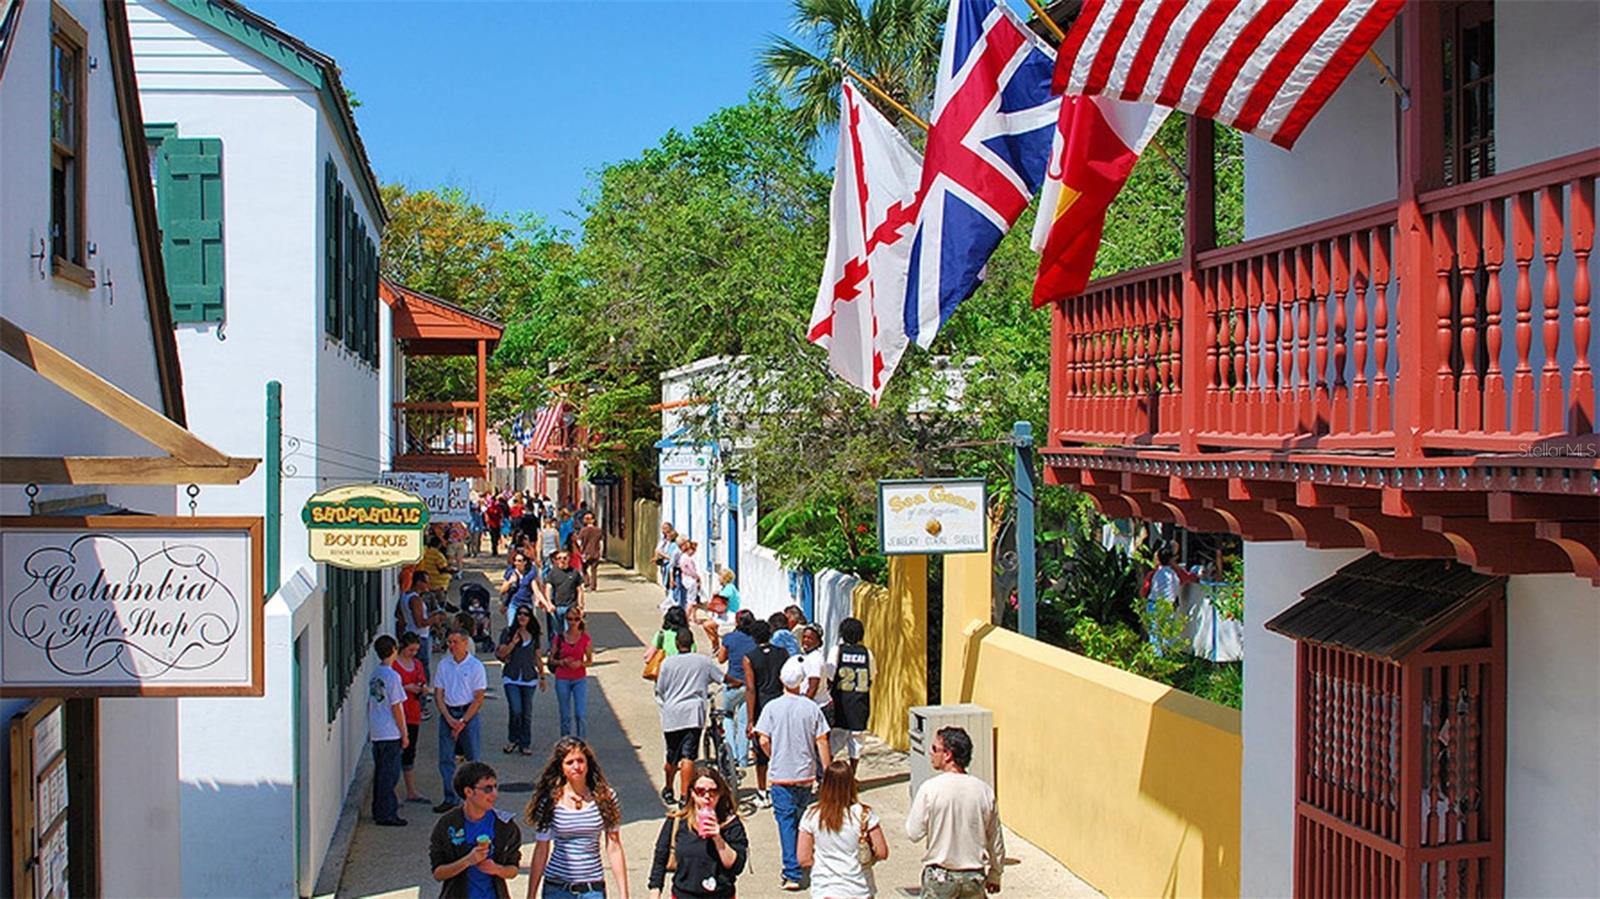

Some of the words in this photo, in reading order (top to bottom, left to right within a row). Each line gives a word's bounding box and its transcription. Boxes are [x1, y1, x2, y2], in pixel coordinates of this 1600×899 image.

[888, 494, 927, 513] Sea
[312, 506, 421, 524] SHOPAHOLIC
[323, 533, 408, 548] BOUTIQUE
[43, 564, 209, 603] Columbia
[60, 606, 115, 648] Gift
[122, 606, 190, 648] Shop
[837, 666, 868, 692] 21
